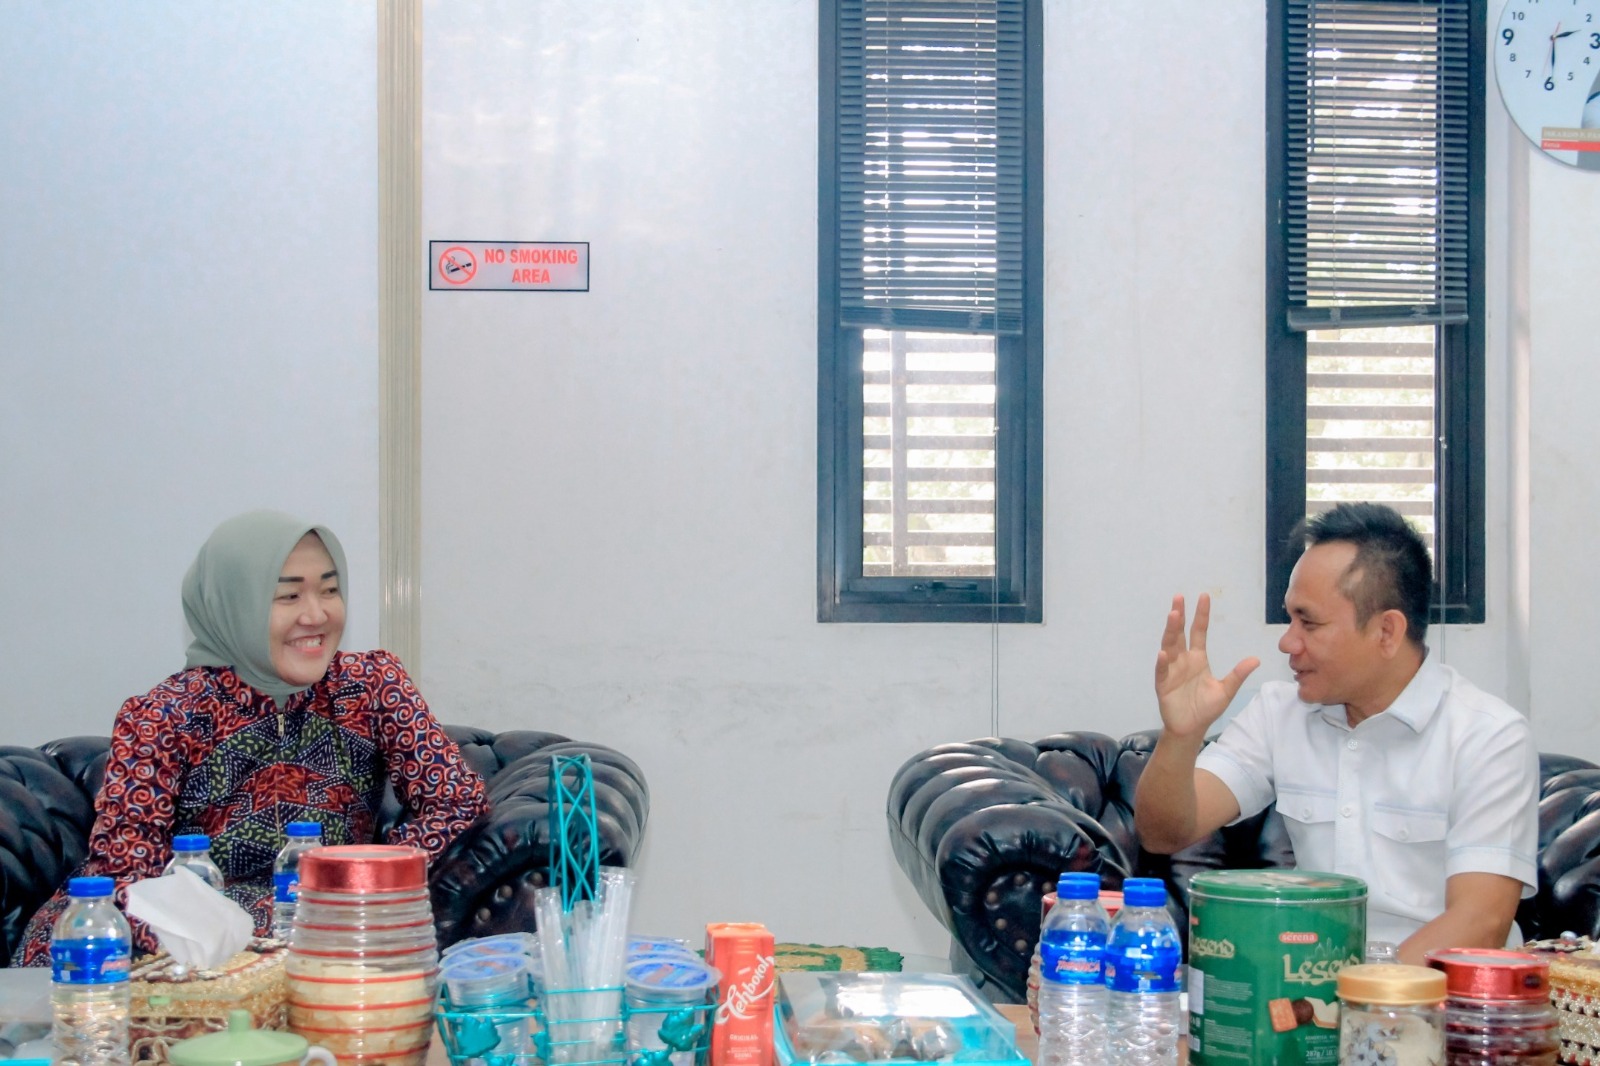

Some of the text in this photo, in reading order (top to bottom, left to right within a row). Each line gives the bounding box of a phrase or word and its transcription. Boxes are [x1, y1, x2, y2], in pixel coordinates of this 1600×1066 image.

[1512, 12, 1525, 21] 10
[1586, 13, 1592, 23] 2
[1502, 28, 1514, 45] 9
[1589, 32, 1600, 49] 3
[1509, 53, 1516, 62] 8
[1583, 56, 1590, 65] 4
[1525, 70, 1531, 78] 7
[1567, 72, 1574, 81] 5
[1544, 76, 1555, 91] 6
[484, 249, 578, 264] NO SMOKING
[511, 269, 551, 284] AREA
[1281, 933, 1315, 941] serena
